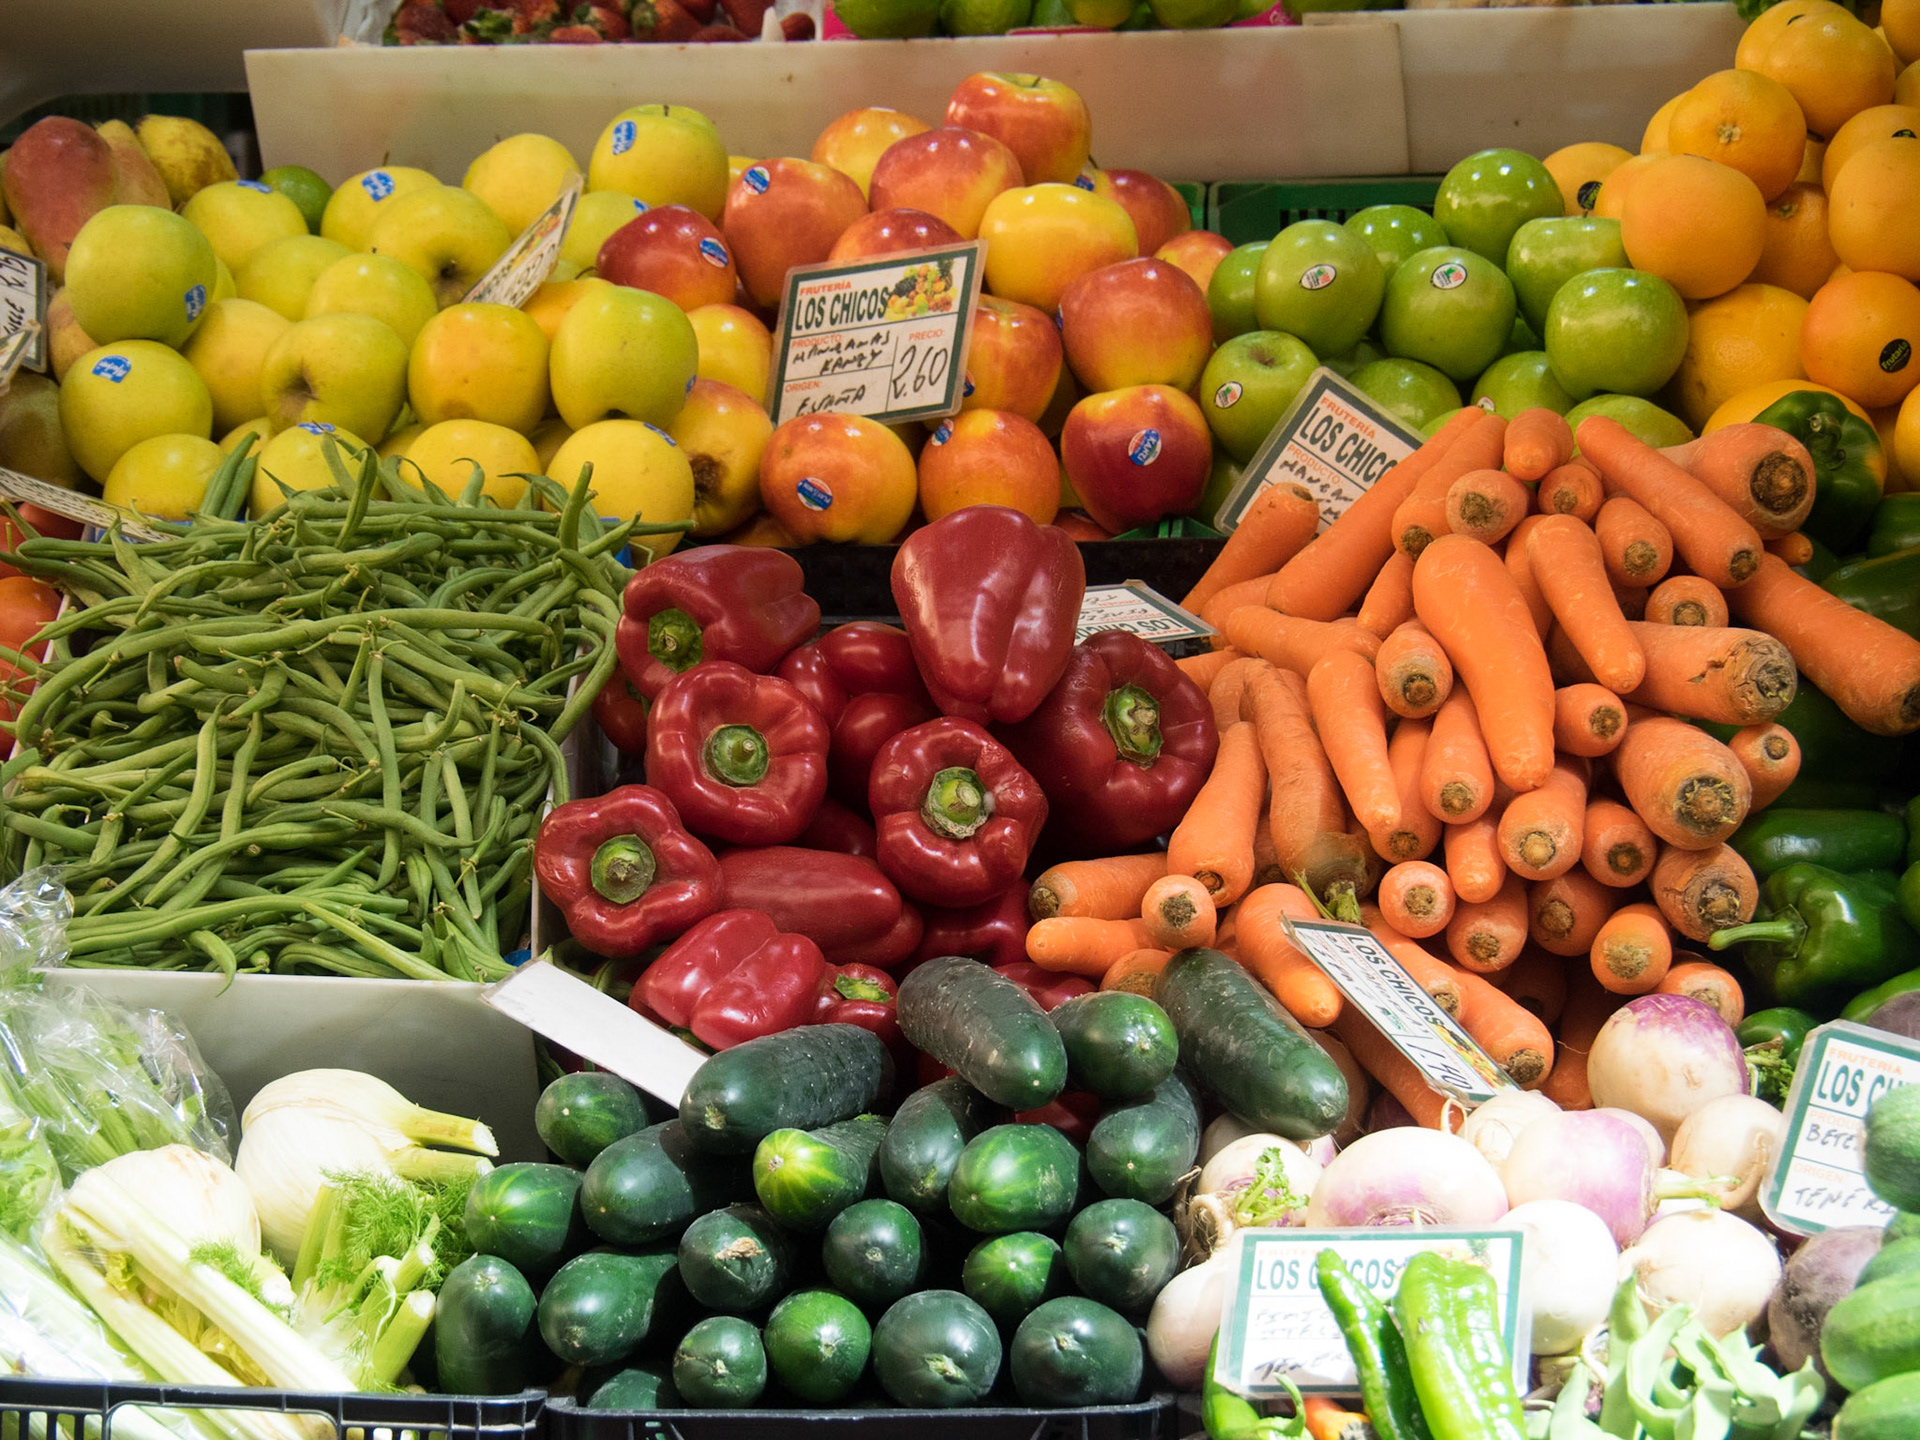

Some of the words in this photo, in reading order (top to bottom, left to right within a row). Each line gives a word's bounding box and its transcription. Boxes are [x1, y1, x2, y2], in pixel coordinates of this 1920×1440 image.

[795, 296, 826, 331] LOS
[829, 285, 888, 326] CHICOS
[800, 281, 852, 296] FRUTERÍA
[908, 329, 945, 342] PRECIO:
[892, 345, 949, 400] 2.60
[1320, 396, 1376, 439] FRUTERÍA
[1299, 407, 1344, 453] LOS
[1335, 433, 1399, 484] CHICO
[1137, 618, 1184, 632] LOS
[1346, 936, 1386, 966] LOS
[1379, 969, 1446, 1028] CHICOS
[1405, 1042, 1473, 1090] 1.40
[1828, 1047, 1903, 1075] FRUTERÍA
[1816, 1060, 1864, 1107] LOS
[1805, 1123, 1858, 1151] BETE
[1255, 1259, 1300, 1290] LOS
